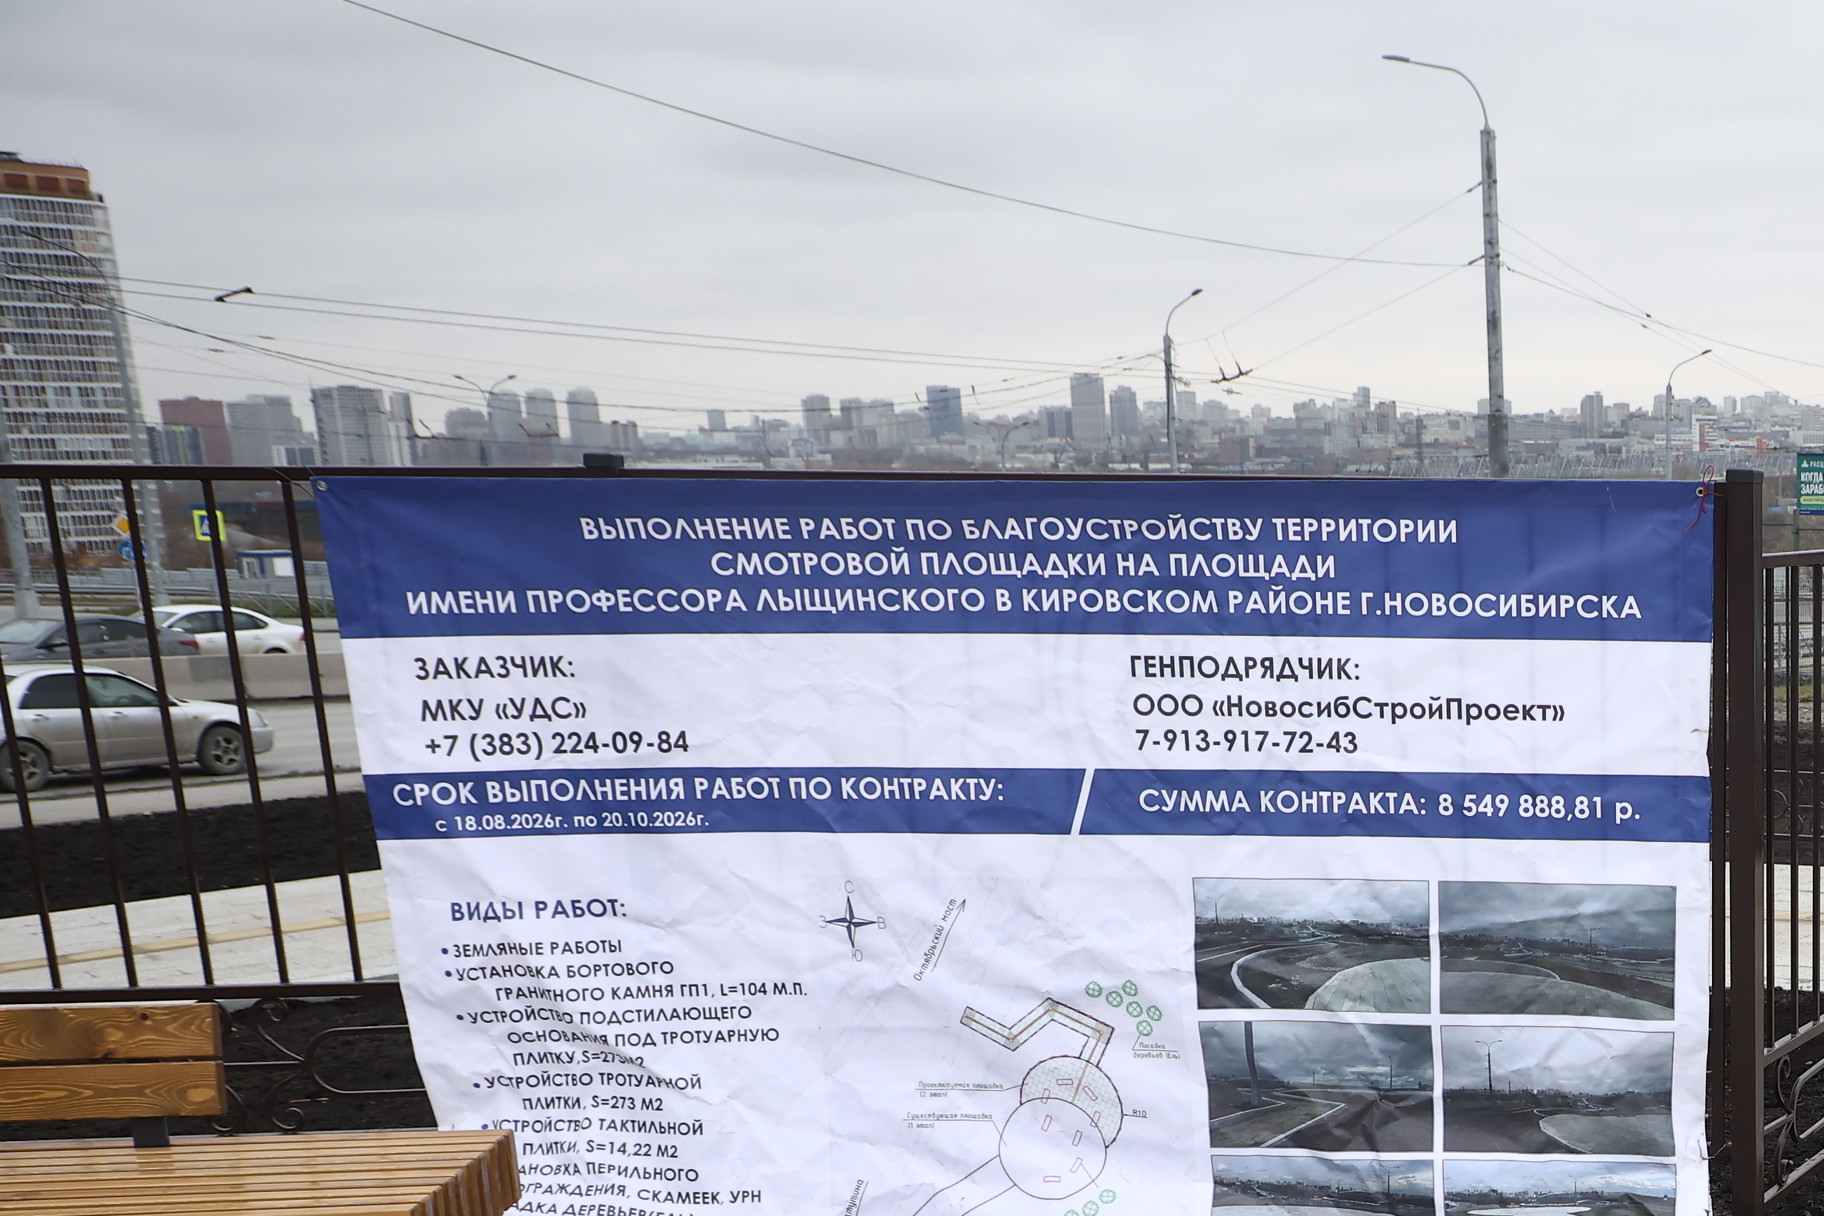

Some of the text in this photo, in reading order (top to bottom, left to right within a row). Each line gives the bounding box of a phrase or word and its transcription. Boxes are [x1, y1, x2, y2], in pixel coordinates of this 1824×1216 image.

[1801, 472, 1823, 483] КОГДА
[580, 514, 1456, 542] ВЫПОЛНЕНИЕ РАБОТ ПО БЛАГОУСТРОЙСТВУ ТЕРРИТОРИИ
[712, 547, 1334, 581] СМОТРОВОЙ ПЛОЩАДКИ НА ПЛОЩАДИ
[407, 586, 1641, 618] ИМЕНИ ПРОФЕССОРА ЛЫЩИНСКОГО В КИРОВСКОМ РАЙОНЕ Г.НОВОСИБИРСКА
[414, 656, 575, 680] ЗАКАЗЧИК:
[1131, 656, 1359, 682] ГЕНПОДРЯДЧИК:
[422, 697, 586, 722] МКУ «УДС»
[1133, 694, 1564, 725] ООО «НовосибСтройПроект»
[426, 731, 688, 762] +7 (383) 224-09-84
[1136, 729, 1357, 753] 7-913-917-72-43
[394, 777, 1003, 805] СРОК ВЫПОЛНЕНИЯ РАБОТ ПО КОНТРАКТУ:
[1140, 789, 1639, 824] СУММА КОНТРАКТА: 8 549 888,81 р.
[436, 812, 708, 831] с 18.08.2026г. по 20.10.2026г.
[844, 880, 855, 894] С
[451, 899, 626, 923] ВИДЫ РАБОТ:
[876, 916, 887, 930] В
[453, 940, 621, 957] ЗЕМЛЯНЫЕ РАБОТЫ
[914, 898, 957, 982] Октябрьский мост
[851, 948, 864, 962] Ю
[456, 960, 674, 981] УСТАНОВКА БОРТОВОГО
[496, 983, 807, 1002] ГРАНИТНОГО КАМНЯ ГП1, L=104 М.П.
[467, 1006, 751, 1025] УСТРОЙСТВО ПОДСТИЛАЮЩЕГО
[507, 1028, 779, 1047] ОСНОВАНИЯ ПОД ТРОТУАРНУЮ
[484, 1071, 701, 1090] УСТРОЙСТВО ТРОТУАРНОЙ
[522, 1095, 663, 1111] ПЛИТКИ, S=273 М2
[599, 1119, 703, 1135] ТАКТИЛЬНОЙ
[523, 1140, 678, 1158] ПЛИТКИ, S=14,22 М2
[519, 1161, 699, 1183] АНОВКА ПЕРИЛЬНОГО
[638, 1189, 723, 1204] СКАМЕЕК,
[730, 1190, 761, 1203] УРН
